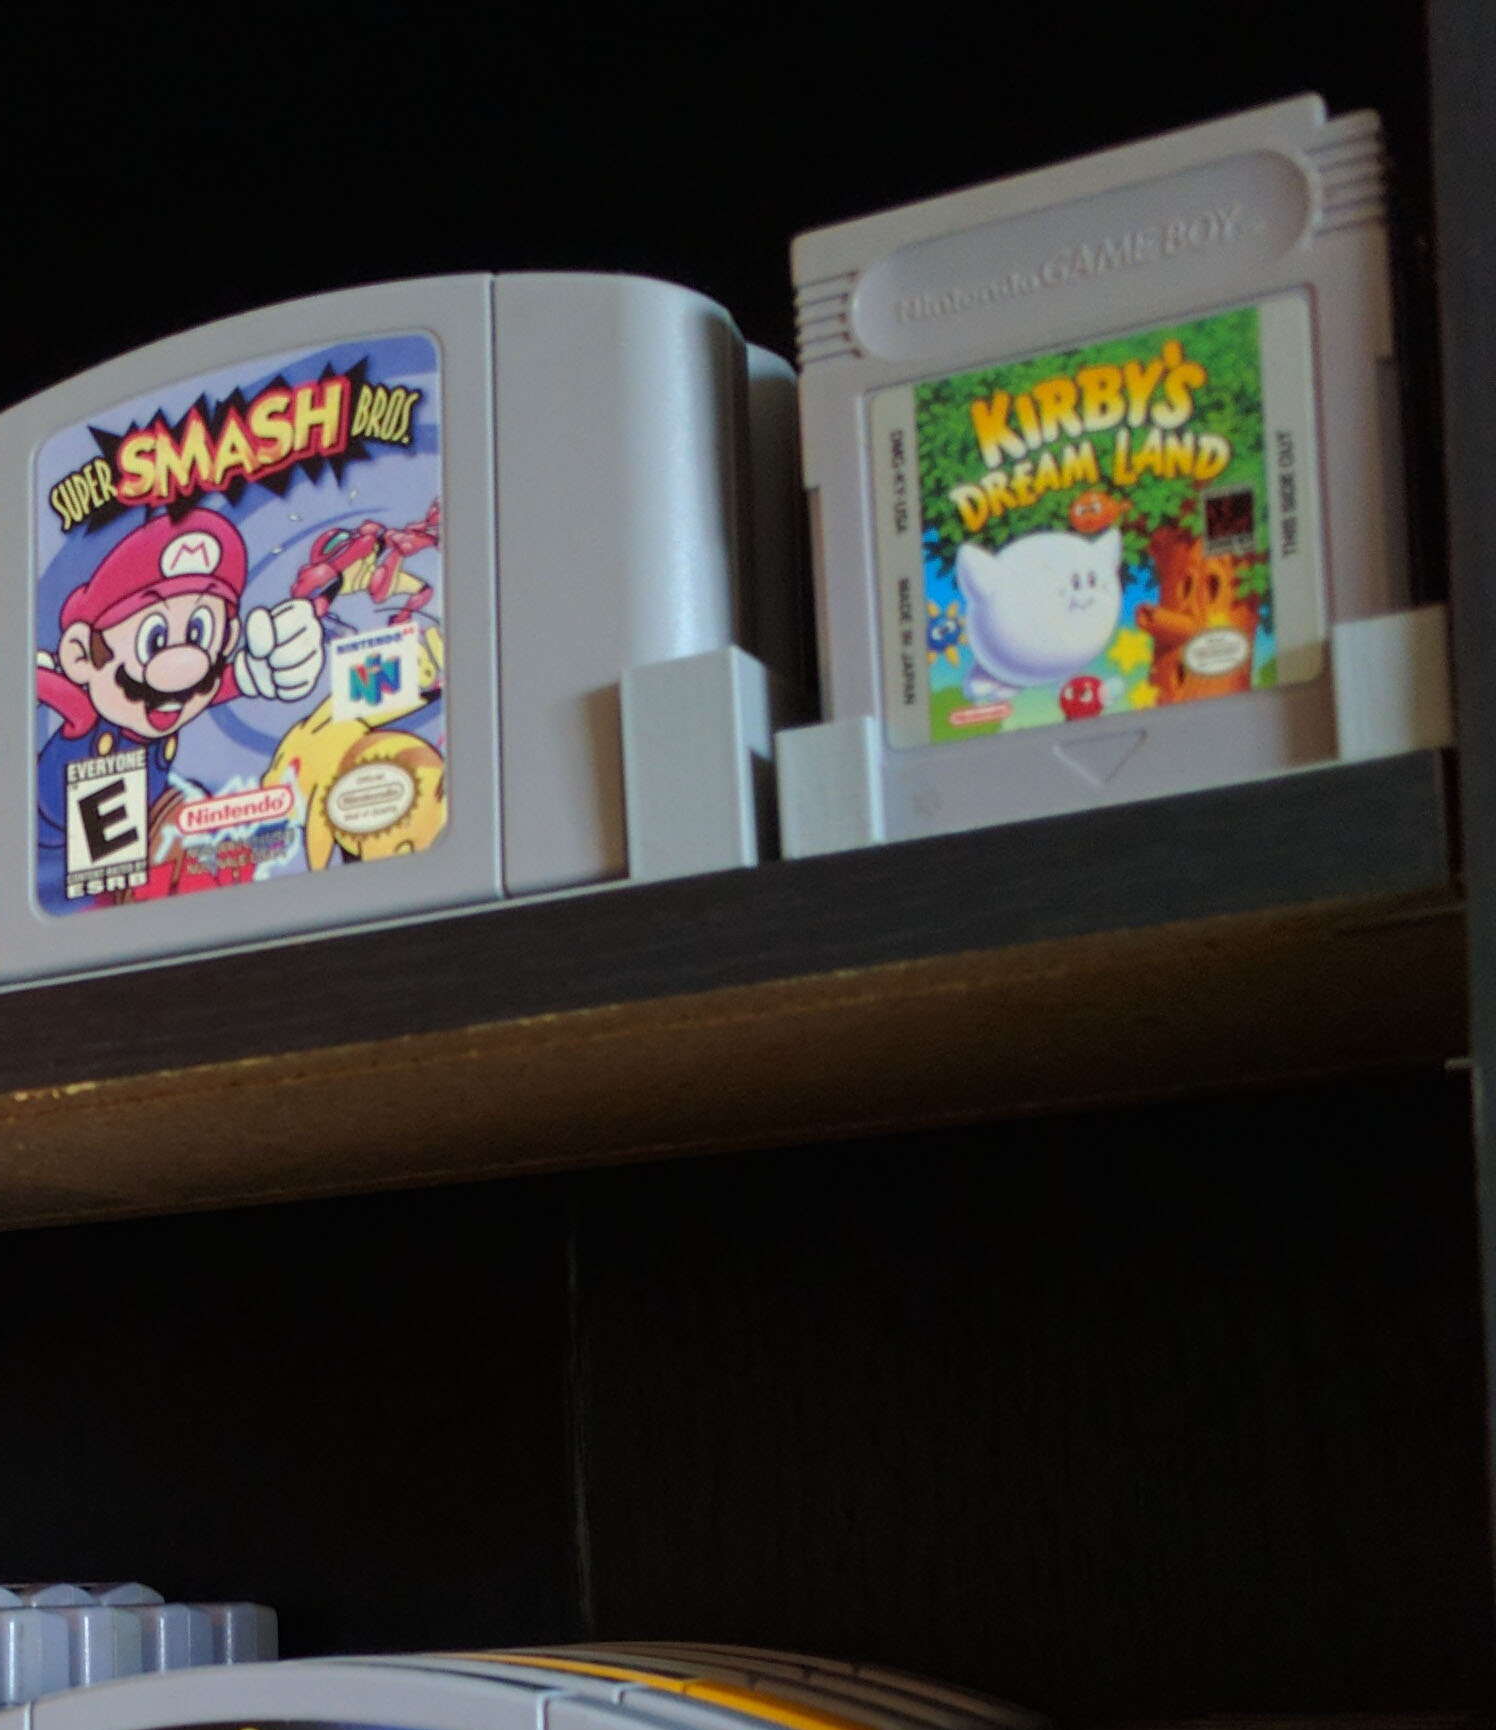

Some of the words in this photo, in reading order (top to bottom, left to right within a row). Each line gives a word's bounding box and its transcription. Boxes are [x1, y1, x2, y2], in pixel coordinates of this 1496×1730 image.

[1158, 205, 1242, 258] BOY
[971, 339, 1207, 471] KIRBY'S
[50, 457, 118, 531] SUPER
[117, 376, 349, 502] SMASH
[350, 386, 419, 444] BROS.
[948, 439, 1100, 533] DREAM
[1113, 427, 1231, 486] LAND
[1276, 430, 1294, 468] OUT
[68, 751, 146, 782] EVERYONE
[78, 778, 139, 862] E
[187, 795, 284, 827] Nintendo
